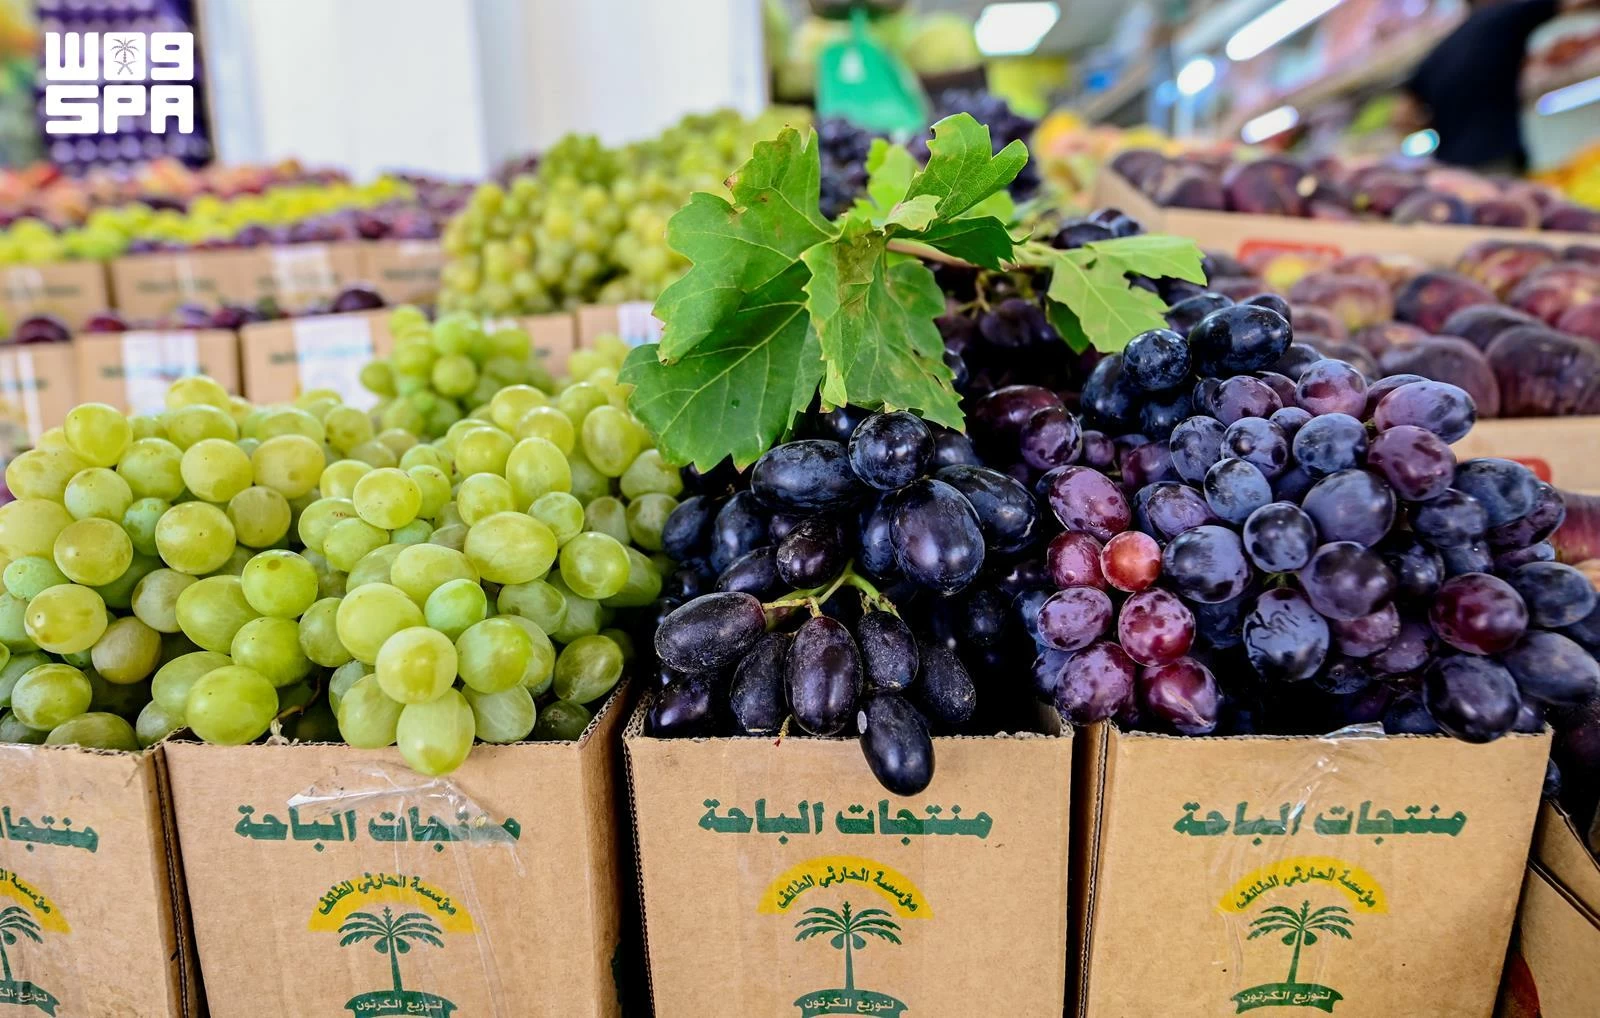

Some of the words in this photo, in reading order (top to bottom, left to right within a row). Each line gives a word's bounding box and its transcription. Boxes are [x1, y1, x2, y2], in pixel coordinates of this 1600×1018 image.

[0, 806, 99, 853] منتجا
[235, 804, 356, 852] الباحة
[698, 799, 824, 845] الباحة
[835, 799, 993, 846] منتجات
[1173, 801, 1306, 846] الباحة
[1314, 800, 1467, 845] منتجات
[11, 873, 51, 914] مؤسسة
[358, 872, 406, 894] الحارثي
[777, 874, 815, 909] الطائف
[819, 866, 869, 888] الحارثي
[873, 870, 919, 912] مؤسسة
[1236, 874, 1279, 909] الطائف
[1284, 865, 1336, 887] الحارثي
[1338, 869, 1376, 907] مؤسسة
[410, 875, 457, 915] مؤسسة
[356, 999, 402, 1011] الكرتون
[406, 1000, 443, 1013] لتوزيع
[804, 997, 852, 1009] الكرتون
[856, 999, 895, 1013] لتوزيع
[1241, 991, 1290, 1003] الكرتون
[1292, 991, 1331, 1004] لتوزيع
